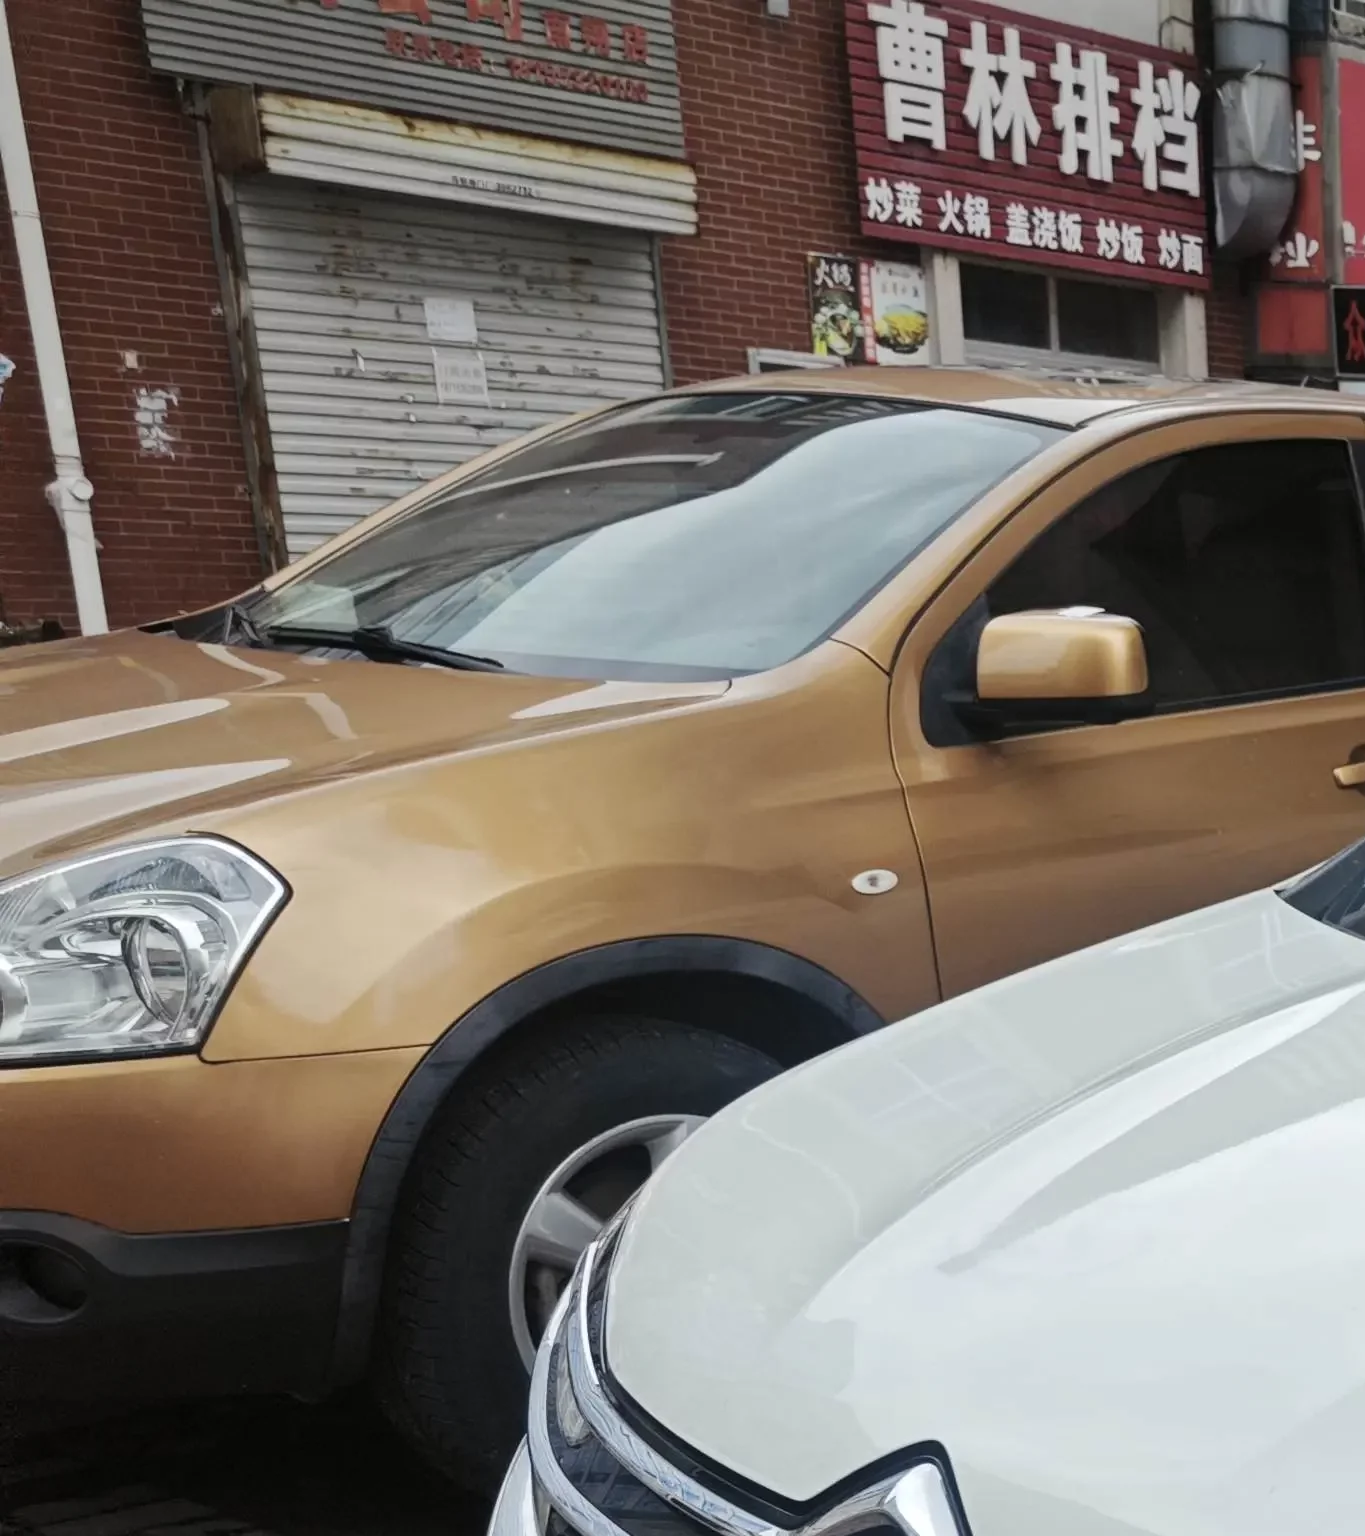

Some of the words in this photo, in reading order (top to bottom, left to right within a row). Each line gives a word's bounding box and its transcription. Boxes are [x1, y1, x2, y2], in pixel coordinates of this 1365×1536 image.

[867, 0, 1201, 198] 曹林排档
[864, 177, 924, 229] 炒菜
[937, 189, 992, 240] 火锅
[1005, 203, 1084, 255] 盖浇饭
[1096, 217, 1145, 266] 炒饭
[1158, 228, 1204, 276] 炒面
